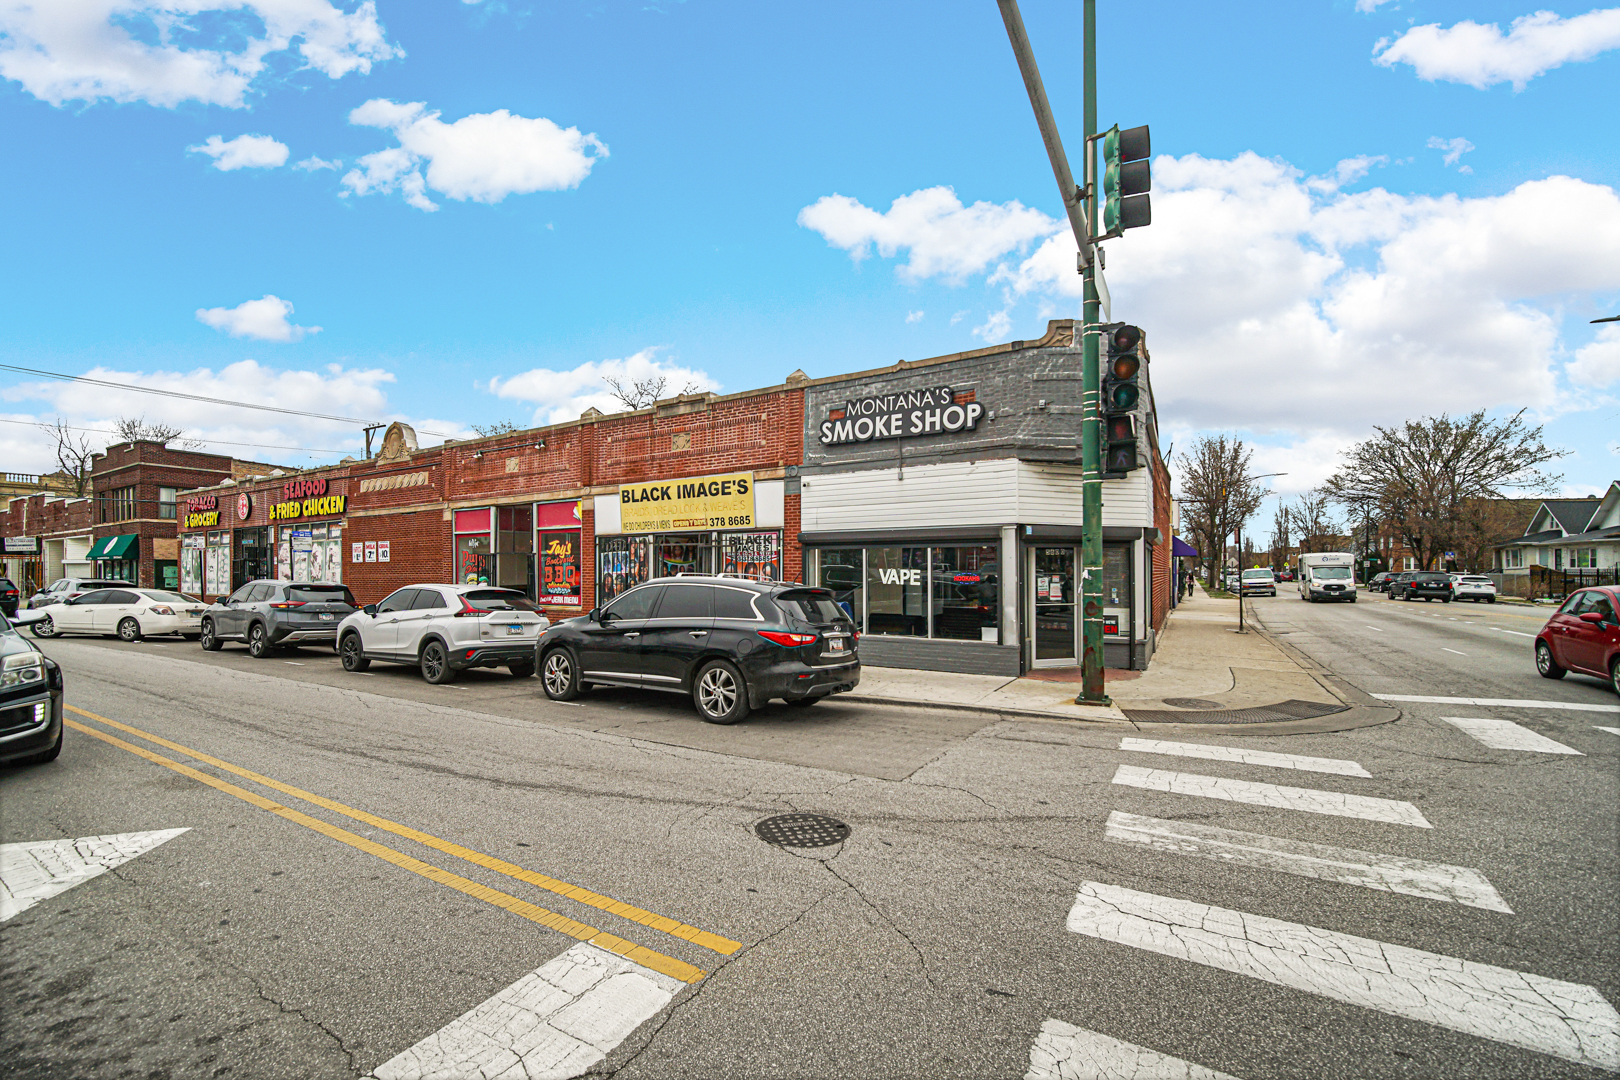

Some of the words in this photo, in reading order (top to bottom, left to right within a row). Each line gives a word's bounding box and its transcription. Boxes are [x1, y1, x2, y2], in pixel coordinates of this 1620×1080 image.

[846, 387, 950, 417] MONTANA'S
[821, 413, 903, 444] SMOKE
[909, 403, 982, 434] SHOP
[283, 479, 326, 499] SEAFOOD
[621, 486, 672, 504] BLACK
[677, 479, 749, 499] IMAGE'S
[186, 495, 216, 511] TOBACCO
[269, 504, 276, 520] &
[276, 501, 300, 519] FRIED
[303, 495, 345, 517] CHICKEN
[653, 504, 678, 516] DREAD
[679, 502, 700, 515] LOCK
[184, 514, 189, 528] &
[189, 511, 219, 528] GROCERY
[709, 517, 725, 527] 378
[728, 515, 751, 525] 8685
[545, 539, 572, 559] Jay's
[729, 534, 772, 545] BLACK
[544, 566, 576, 586] BBQ
[878, 568, 921, 586] VAPE
[1104, 625, 1118, 634] EN
